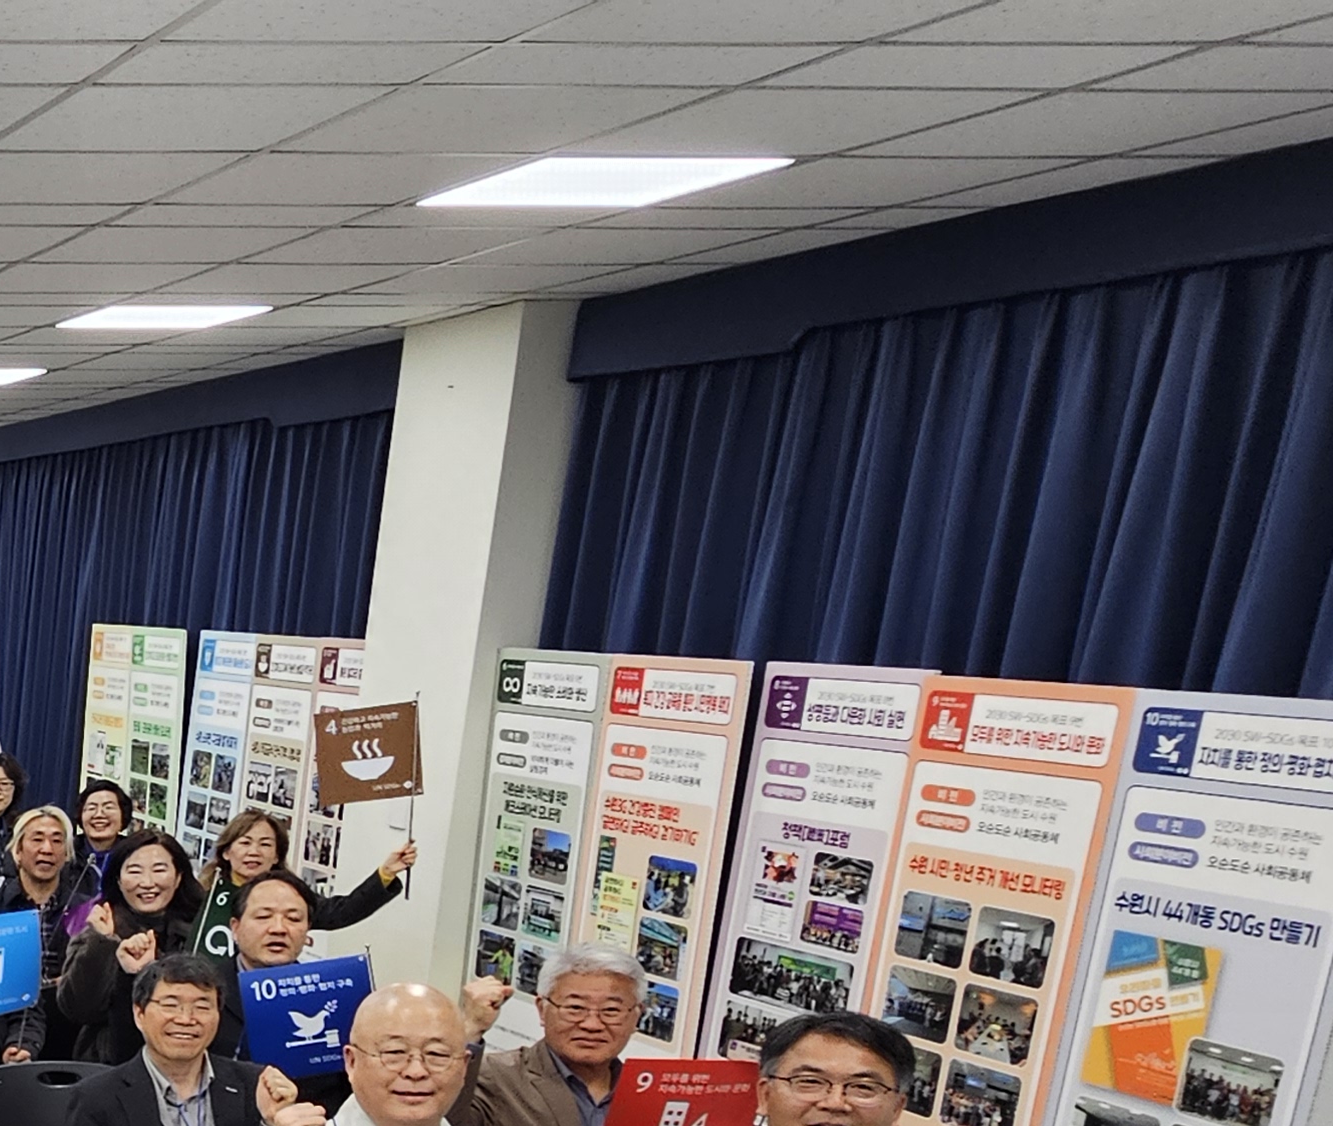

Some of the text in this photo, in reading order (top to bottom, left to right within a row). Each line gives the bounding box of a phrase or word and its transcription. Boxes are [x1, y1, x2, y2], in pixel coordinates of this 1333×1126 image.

[325, 719, 337, 735] 4
[1146, 712, 1160, 726] 10
[1214, 727, 1243, 742] 2030
[1298, 734, 1319, 748] 목표
[1198, 746, 1258, 771] 자치를 통한
[976, 821, 1012, 838] 오순도순
[1214, 819, 1246, 834] 인간과
[1210, 835, 1311, 861] 지속가능한 도시 수원
[909, 854, 929, 876] 수원
[976, 865, 997, 889] 주거
[998, 869, 1020, 892] 개선
[1021, 874, 1066, 900] 모니터링
[1206, 855, 1314, 884] 오순도순 사회공동체
[216, 892, 230, 906] 6
[1114, 891, 1322, 949] 수원시 44개동 SDGs 만들기
[250, 979, 277, 1001] 10
[1110, 995, 1167, 1019] SDGs
[309, 1055, 322, 1064] UN
[636, 1072, 653, 1093] 9
